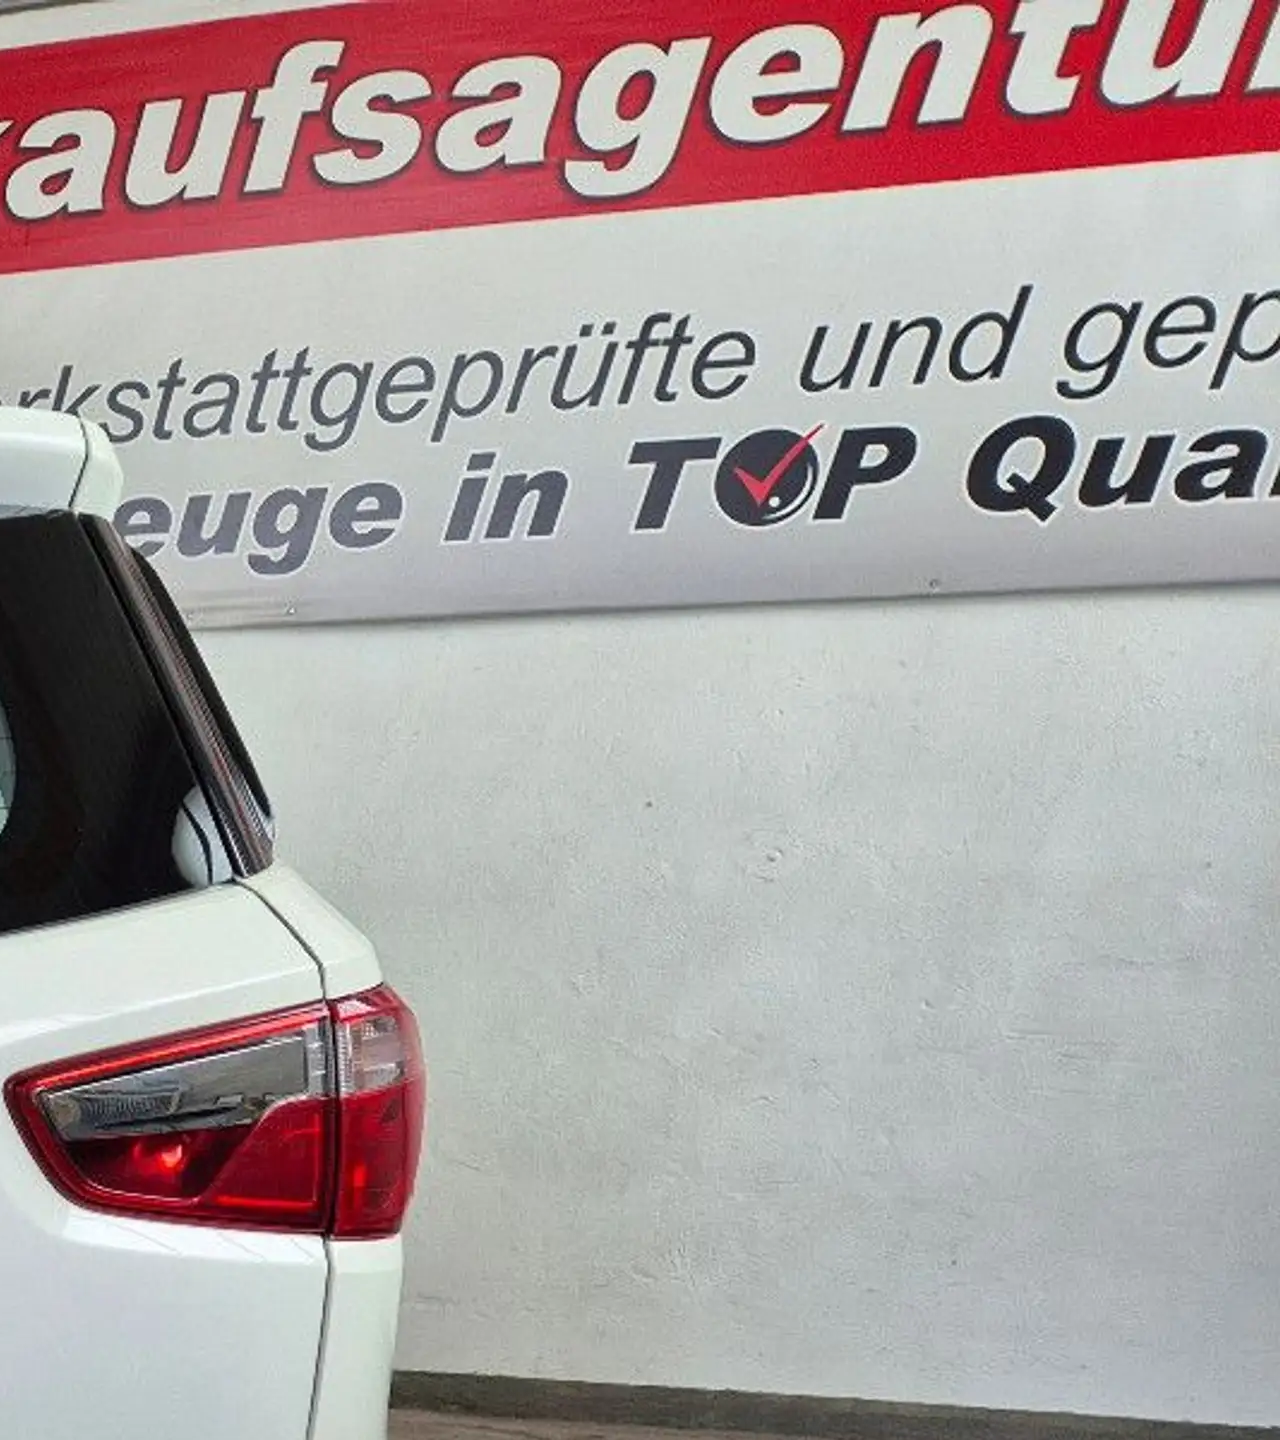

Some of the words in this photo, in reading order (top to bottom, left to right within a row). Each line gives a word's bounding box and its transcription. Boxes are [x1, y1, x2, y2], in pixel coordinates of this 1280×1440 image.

[798, 284, 1034, 391] und
[443, 454, 569, 543] in
[965, 415, 1280, 522] Qua
